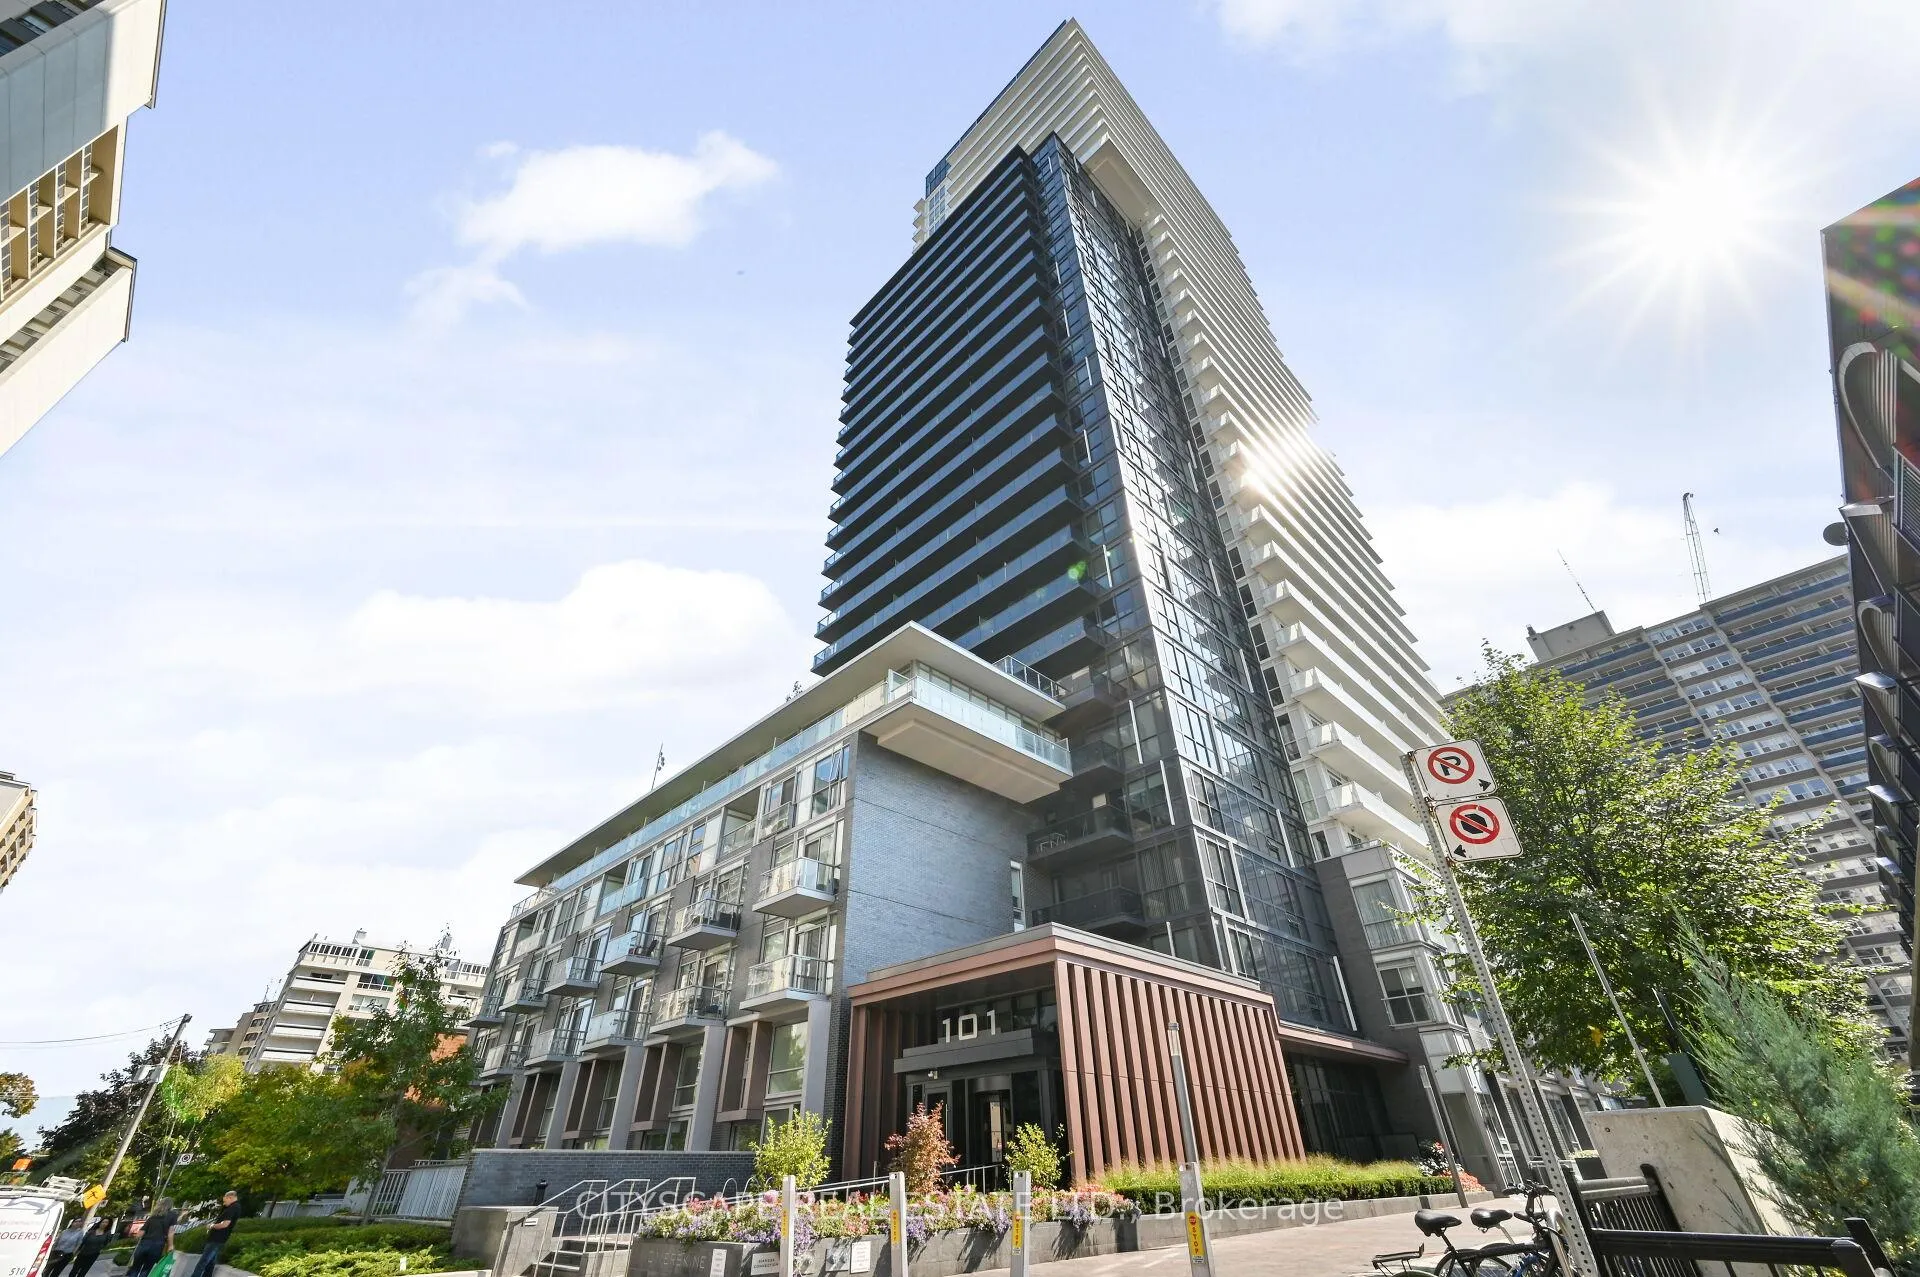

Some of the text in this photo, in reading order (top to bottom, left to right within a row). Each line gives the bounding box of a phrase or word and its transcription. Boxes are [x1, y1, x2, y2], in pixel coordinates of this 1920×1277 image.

[942, 1010, 996, 1043] 101
[0, 1231, 39, 1240] OGERS
[1191, 1226, 1200, 1255] STOP
